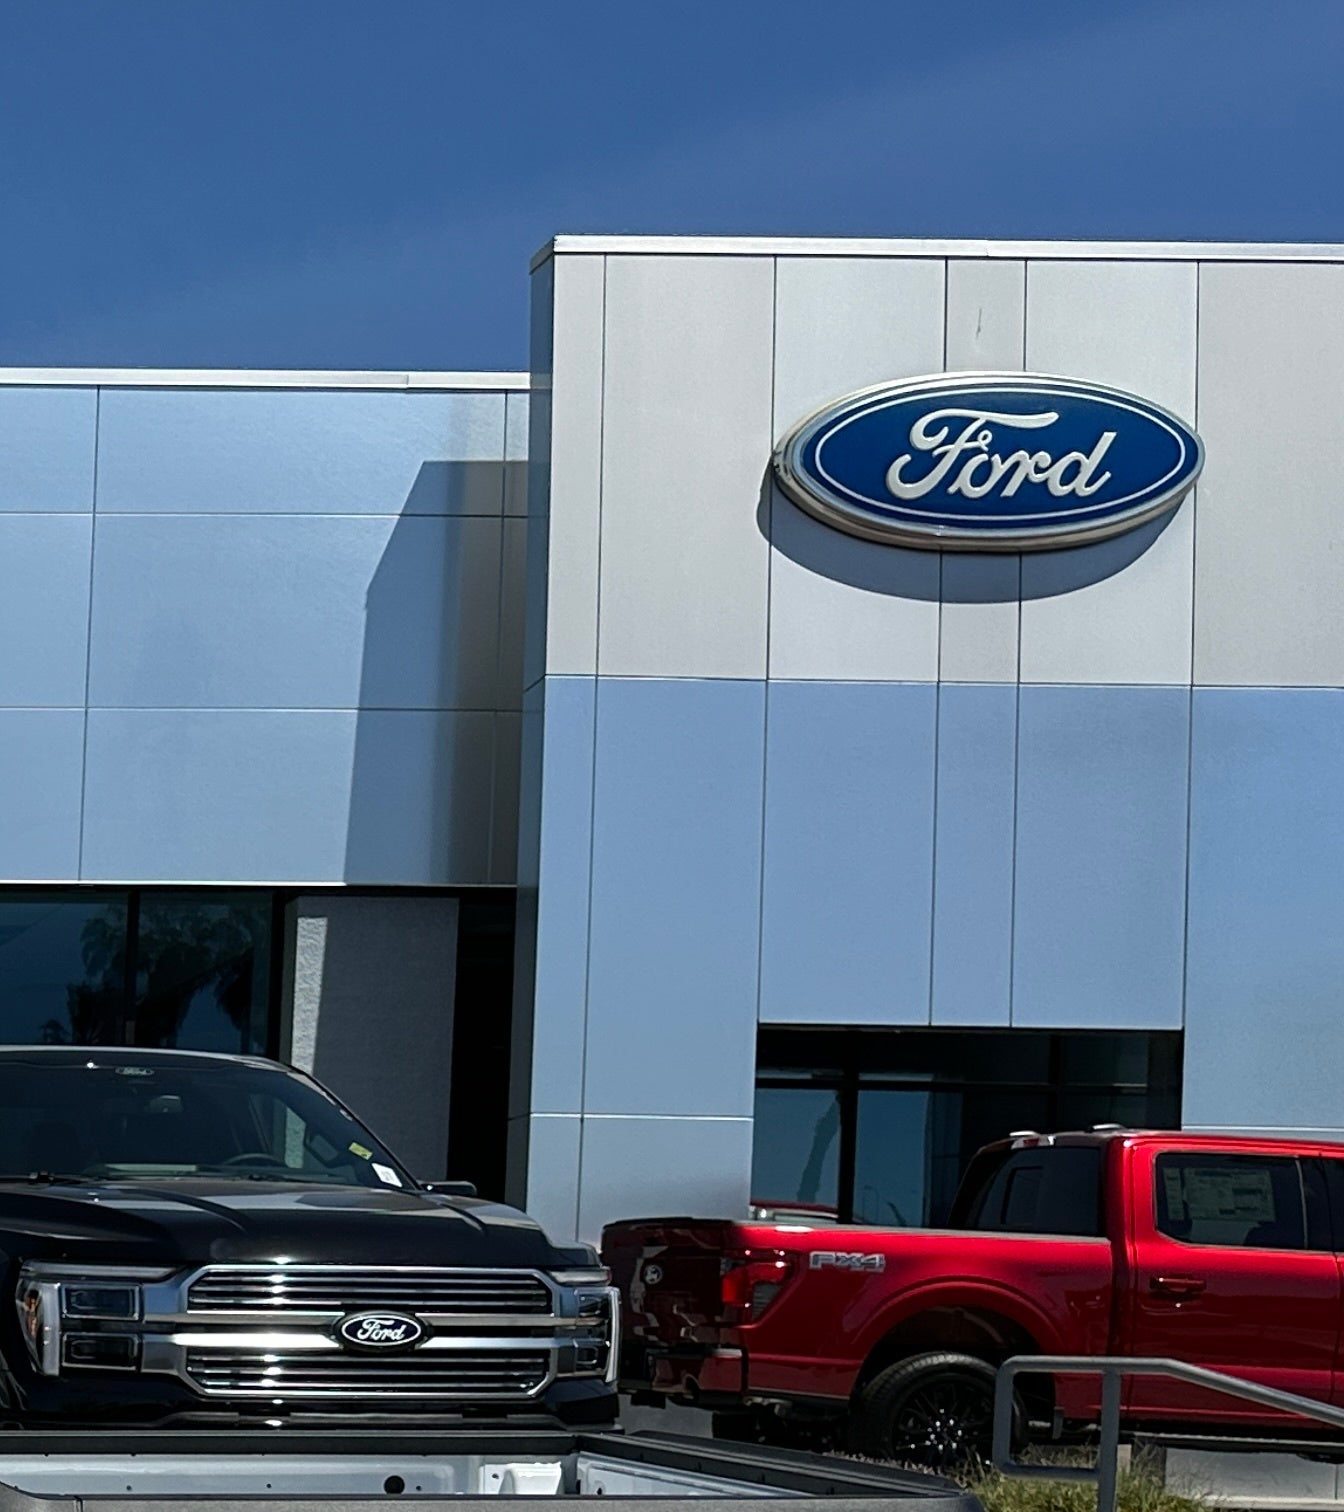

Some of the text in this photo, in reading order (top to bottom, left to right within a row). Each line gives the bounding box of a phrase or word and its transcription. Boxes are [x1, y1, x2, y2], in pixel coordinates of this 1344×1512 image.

[885, 409, 1116, 499] Ford
[810, 1251, 885, 1272] FX4
[357, 1319, 407, 1340] Ford
